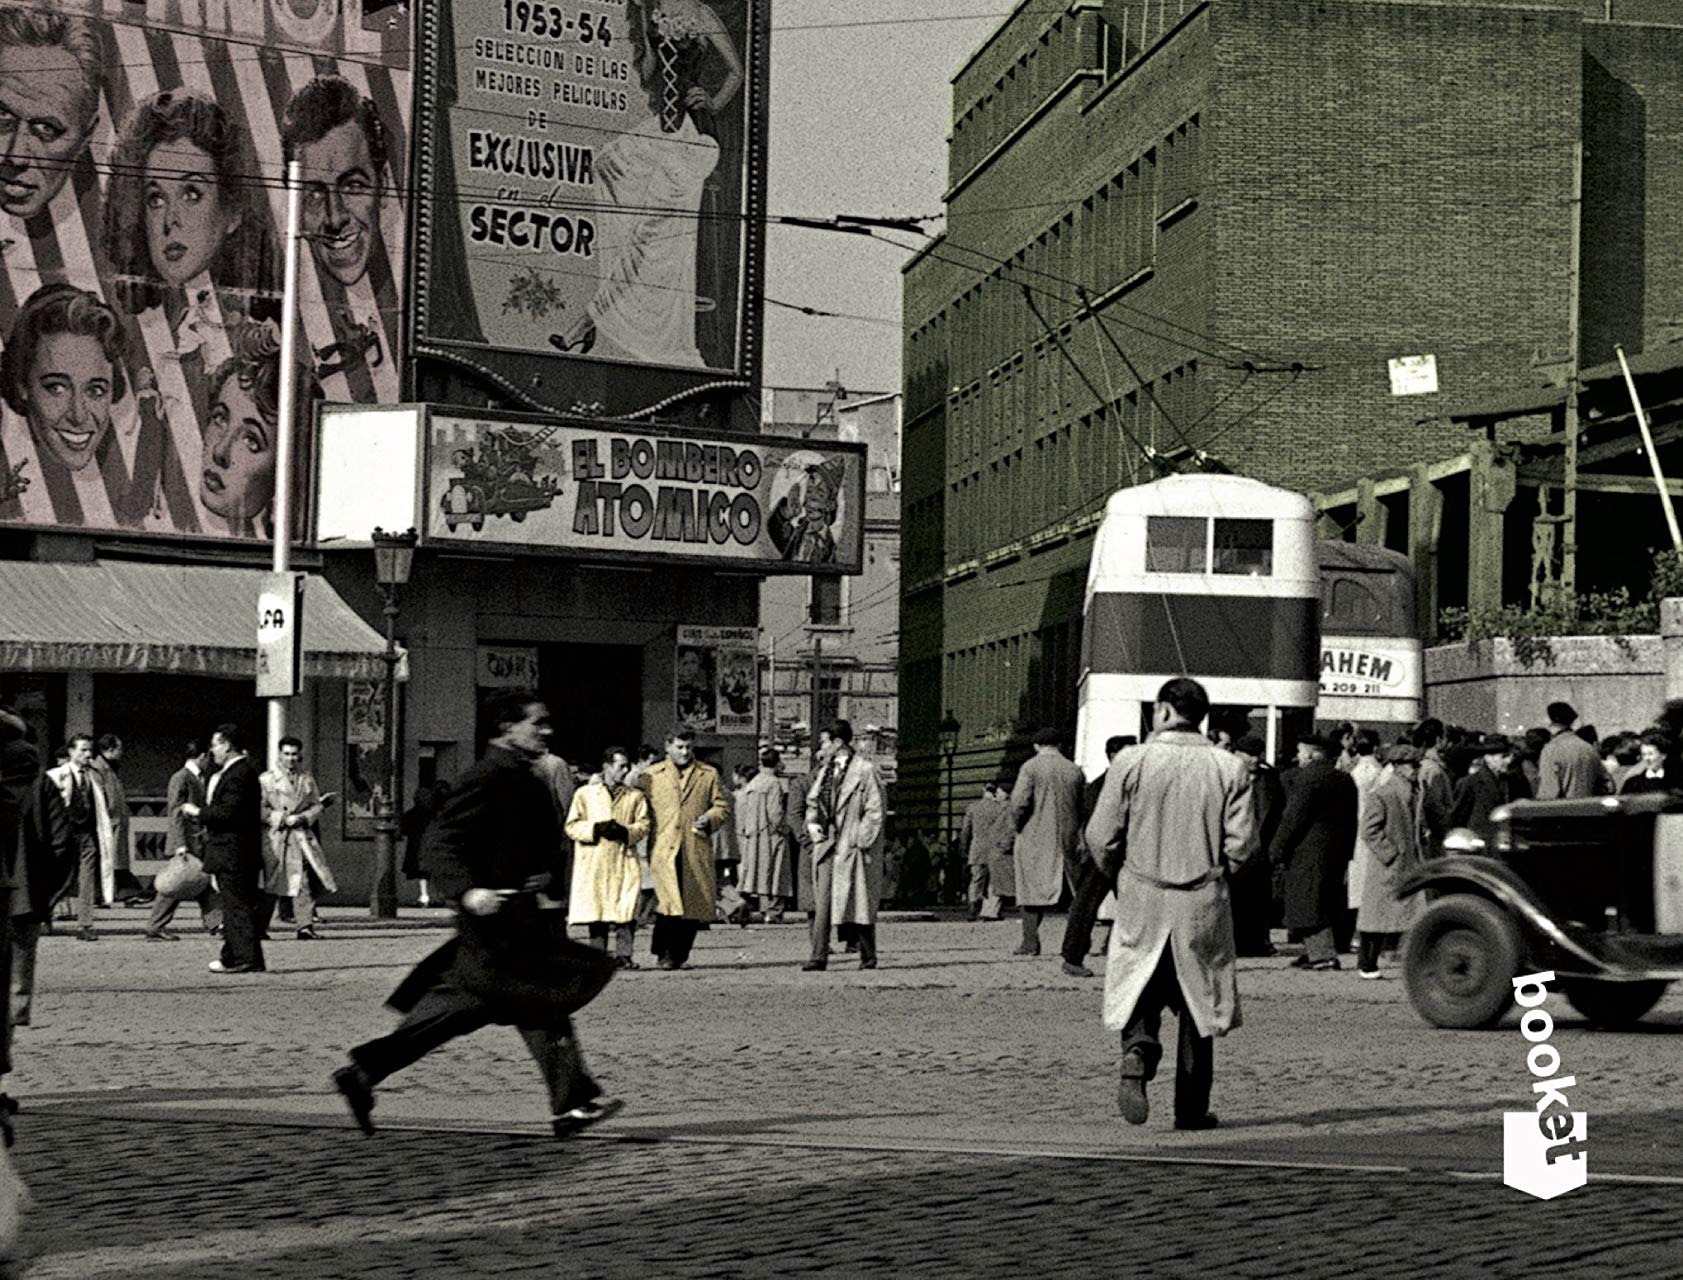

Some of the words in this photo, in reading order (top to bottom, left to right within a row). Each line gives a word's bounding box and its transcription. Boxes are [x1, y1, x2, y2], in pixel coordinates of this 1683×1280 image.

[474, 38, 565, 71] SELECCION
[575, 55, 594, 75] DE
[602, 59, 628, 81] LAS
[475, 70, 541, 98] MEJORES
[553, 82, 627, 112] PELICULAS
[528, 110, 547, 129] DE
[469, 132, 594, 185] EXCLUSIVA
[470, 205, 595, 257] SECTOR
[572, 438, 605, 481] EL
[610, 437, 762, 490] BOMBERO
[572, 480, 762, 546] ATOMICO
